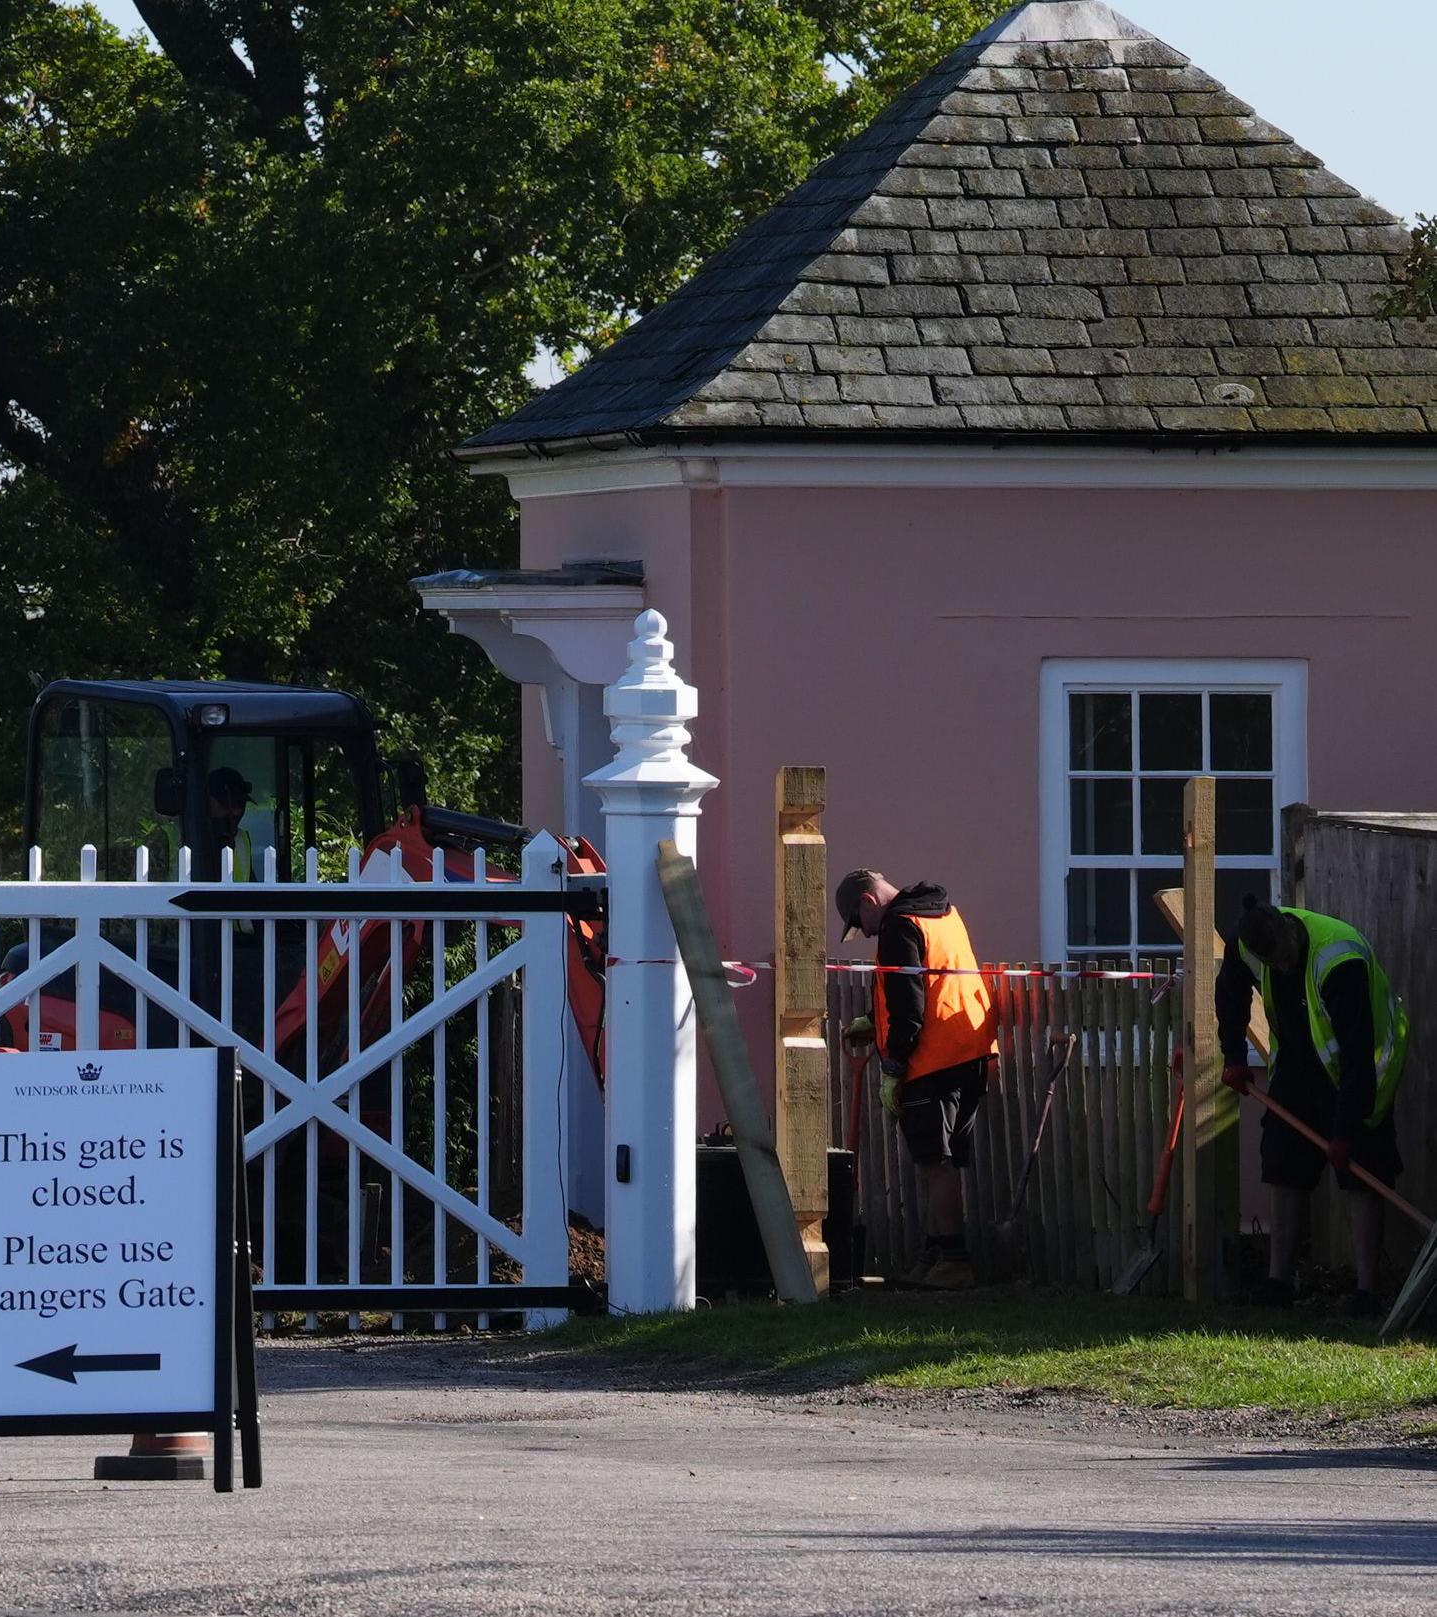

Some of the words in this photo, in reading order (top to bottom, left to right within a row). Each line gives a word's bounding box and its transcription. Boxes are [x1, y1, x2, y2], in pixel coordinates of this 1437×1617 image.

[14, 1084, 79, 1097] WINDSOR
[80, 1083, 128, 1096] GREAT
[129, 1082, 164, 1095] PARK
[78, 1136, 146, 1169] gate
[158, 1129, 184, 1160] is
[32, 1175, 146, 1207] closed.
[2, 1235, 108, 1266] Please
[120, 1239, 174, 1264] use
[118, 1278, 205, 1309] Gate.
